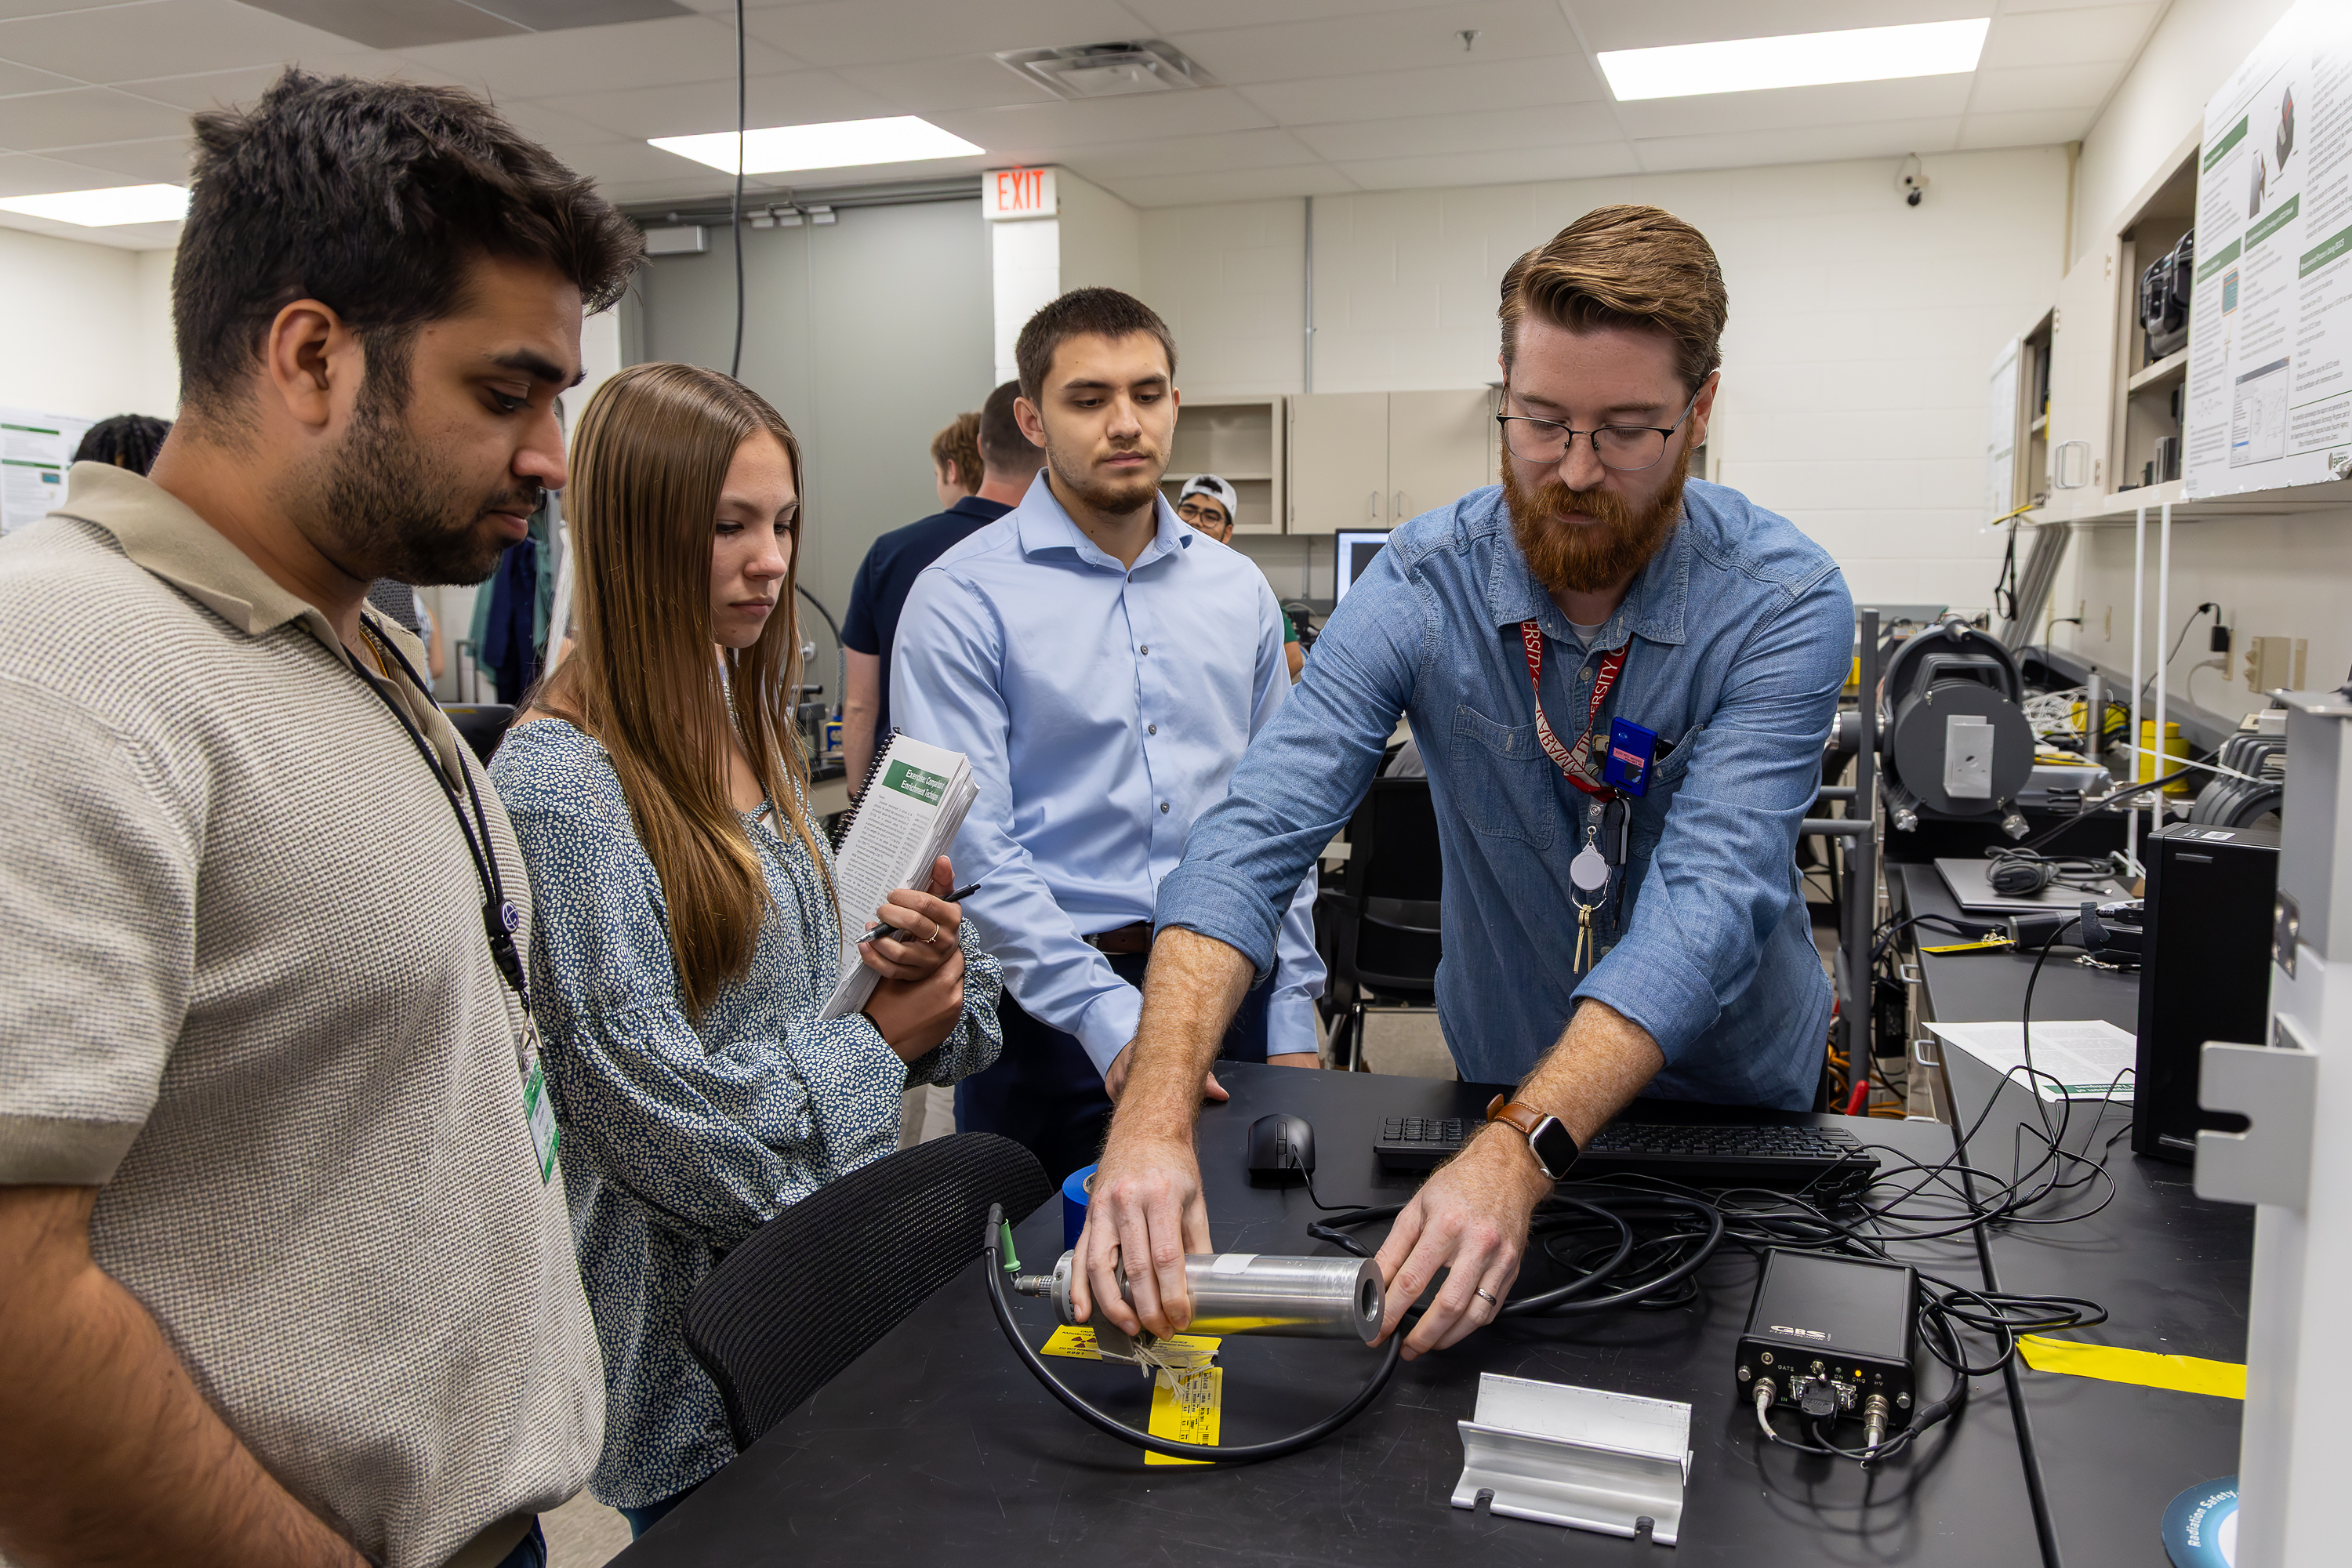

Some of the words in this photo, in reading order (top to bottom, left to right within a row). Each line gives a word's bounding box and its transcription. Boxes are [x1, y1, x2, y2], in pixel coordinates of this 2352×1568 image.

[997, 170, 1044, 211] EXIT
[1522, 621, 1541, 675] ERSITY
[1589, 659, 1619, 717] ERSITY
[900, 780, 926, 797] Enrichment
[1770, 1325, 1826, 1338] GBS
[2185, 1508, 2207, 1548] Radiation
